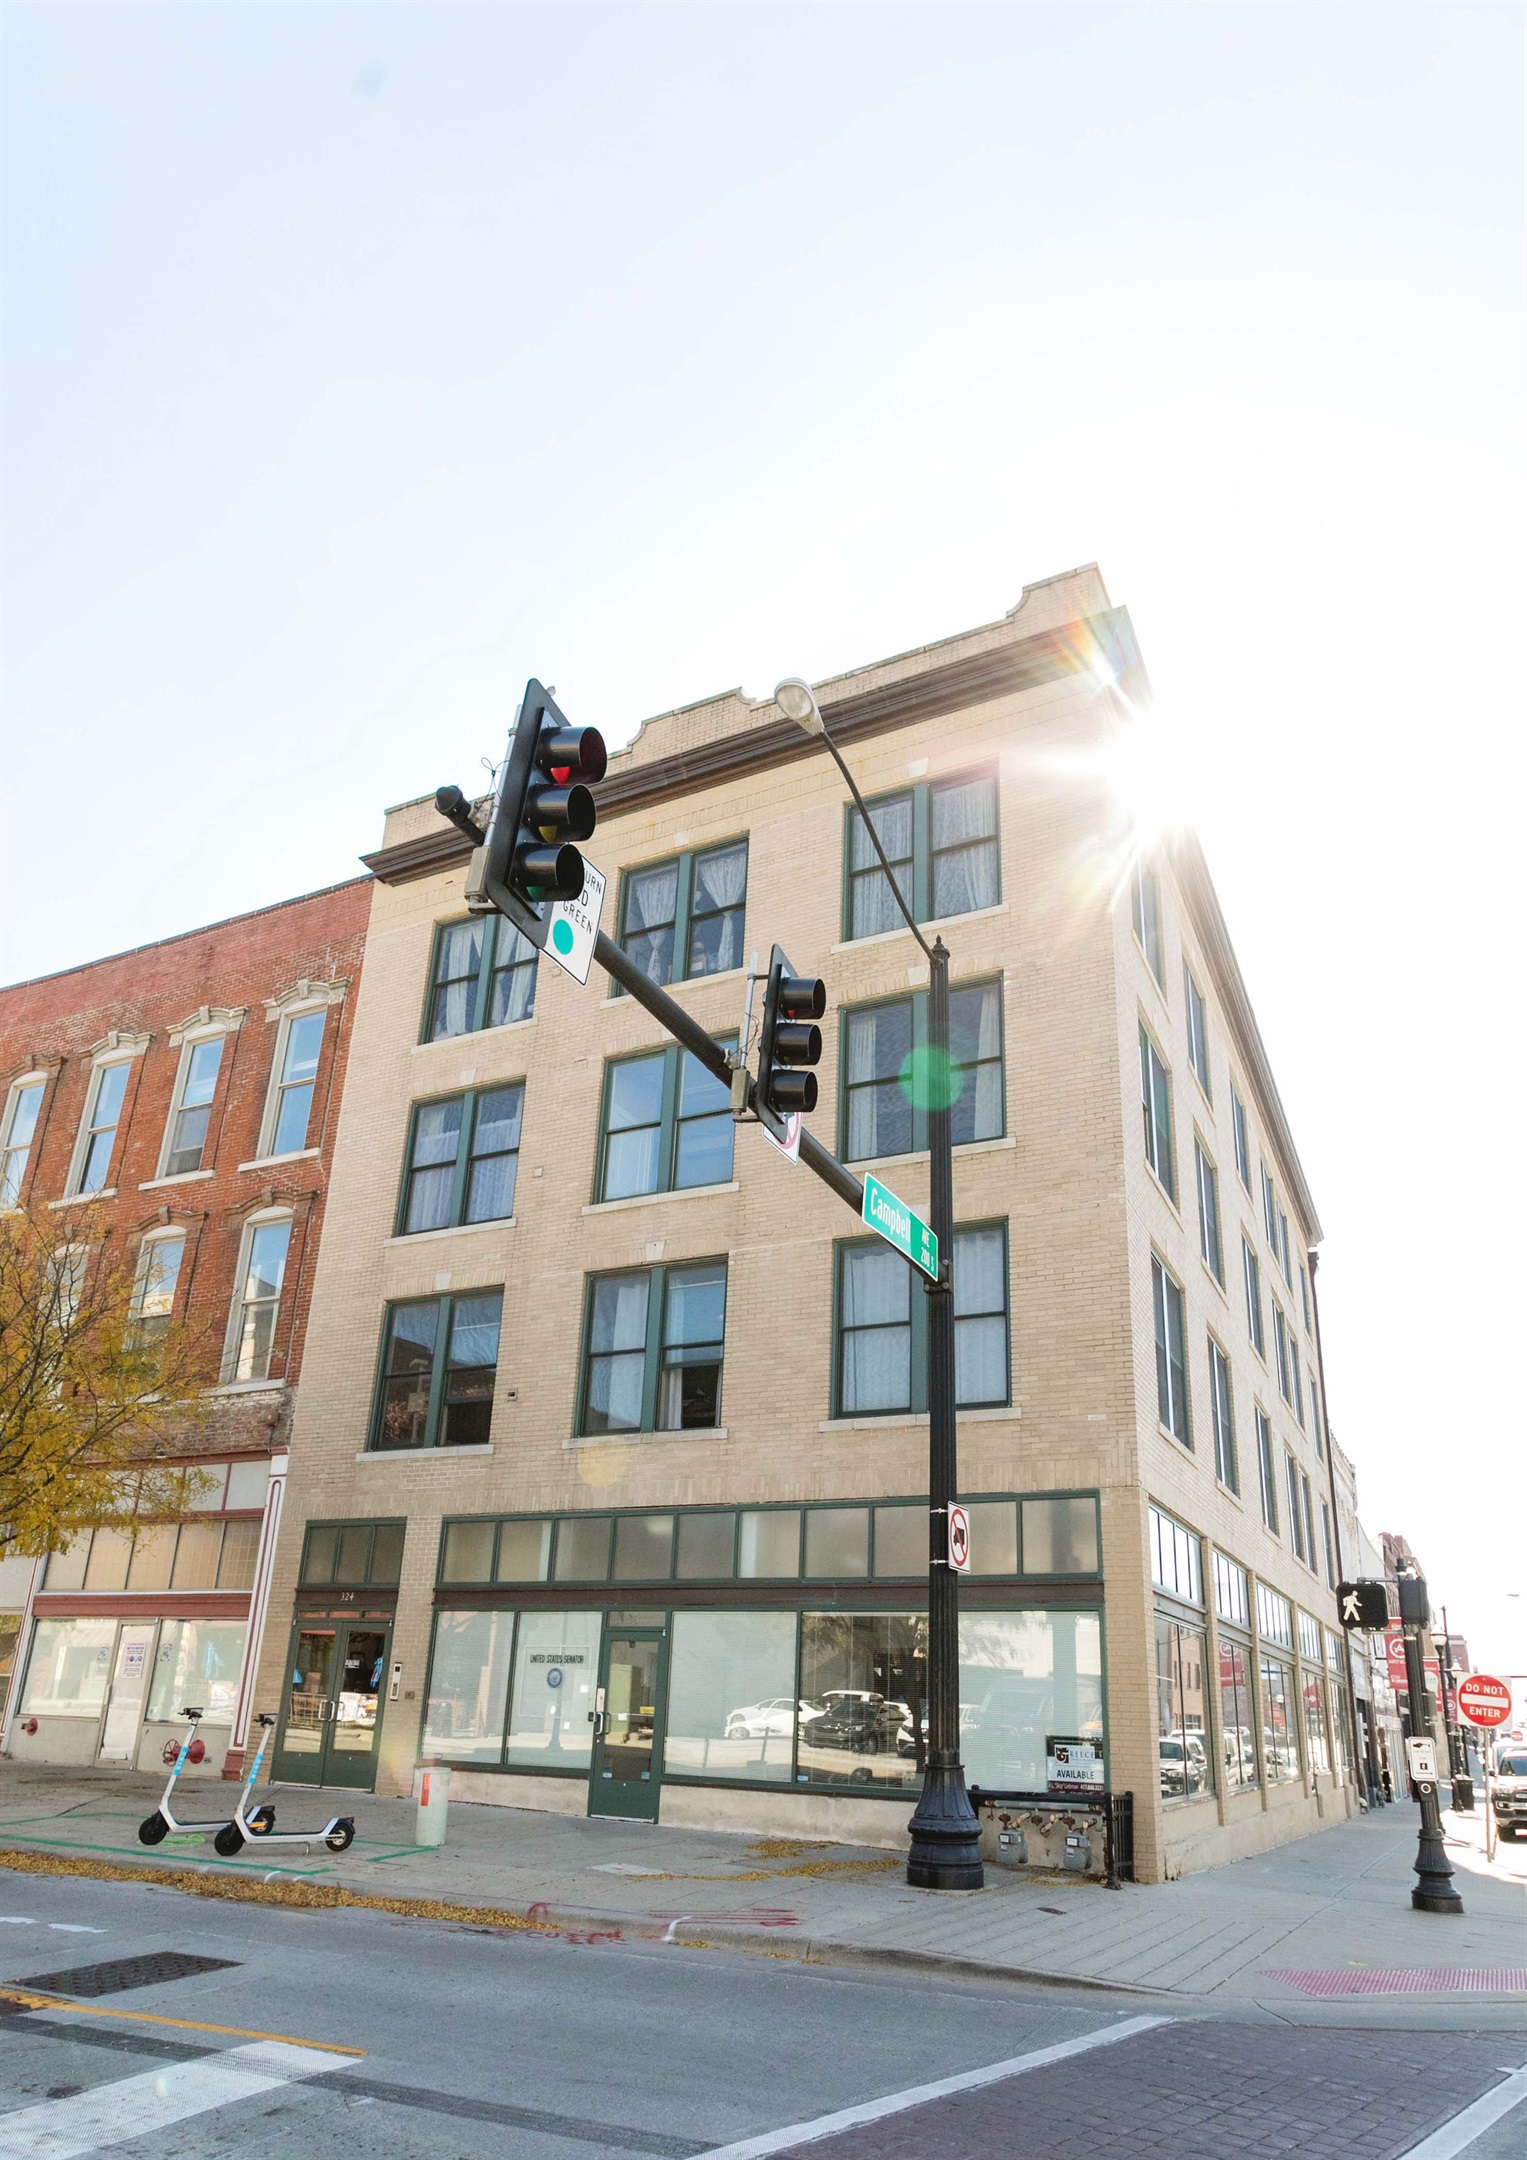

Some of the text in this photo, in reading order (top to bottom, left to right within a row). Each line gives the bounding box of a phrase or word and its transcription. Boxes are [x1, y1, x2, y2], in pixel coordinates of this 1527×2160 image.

[584, 867, 602, 895] URN
[562, 900, 592, 935] GREEN
[870, 1187, 911, 1244] Campbell
[340, 1592, 355, 1602] 324
[529, 1654, 584, 1664] UNITED STATES SENATOR
[1465, 1683, 1480, 1693] DO
[1483, 1685, 1504, 1696] NOT
[1469, 1706, 1501, 1718] ENTER
[1056, 1769, 1095, 1780] AVAILABLE
